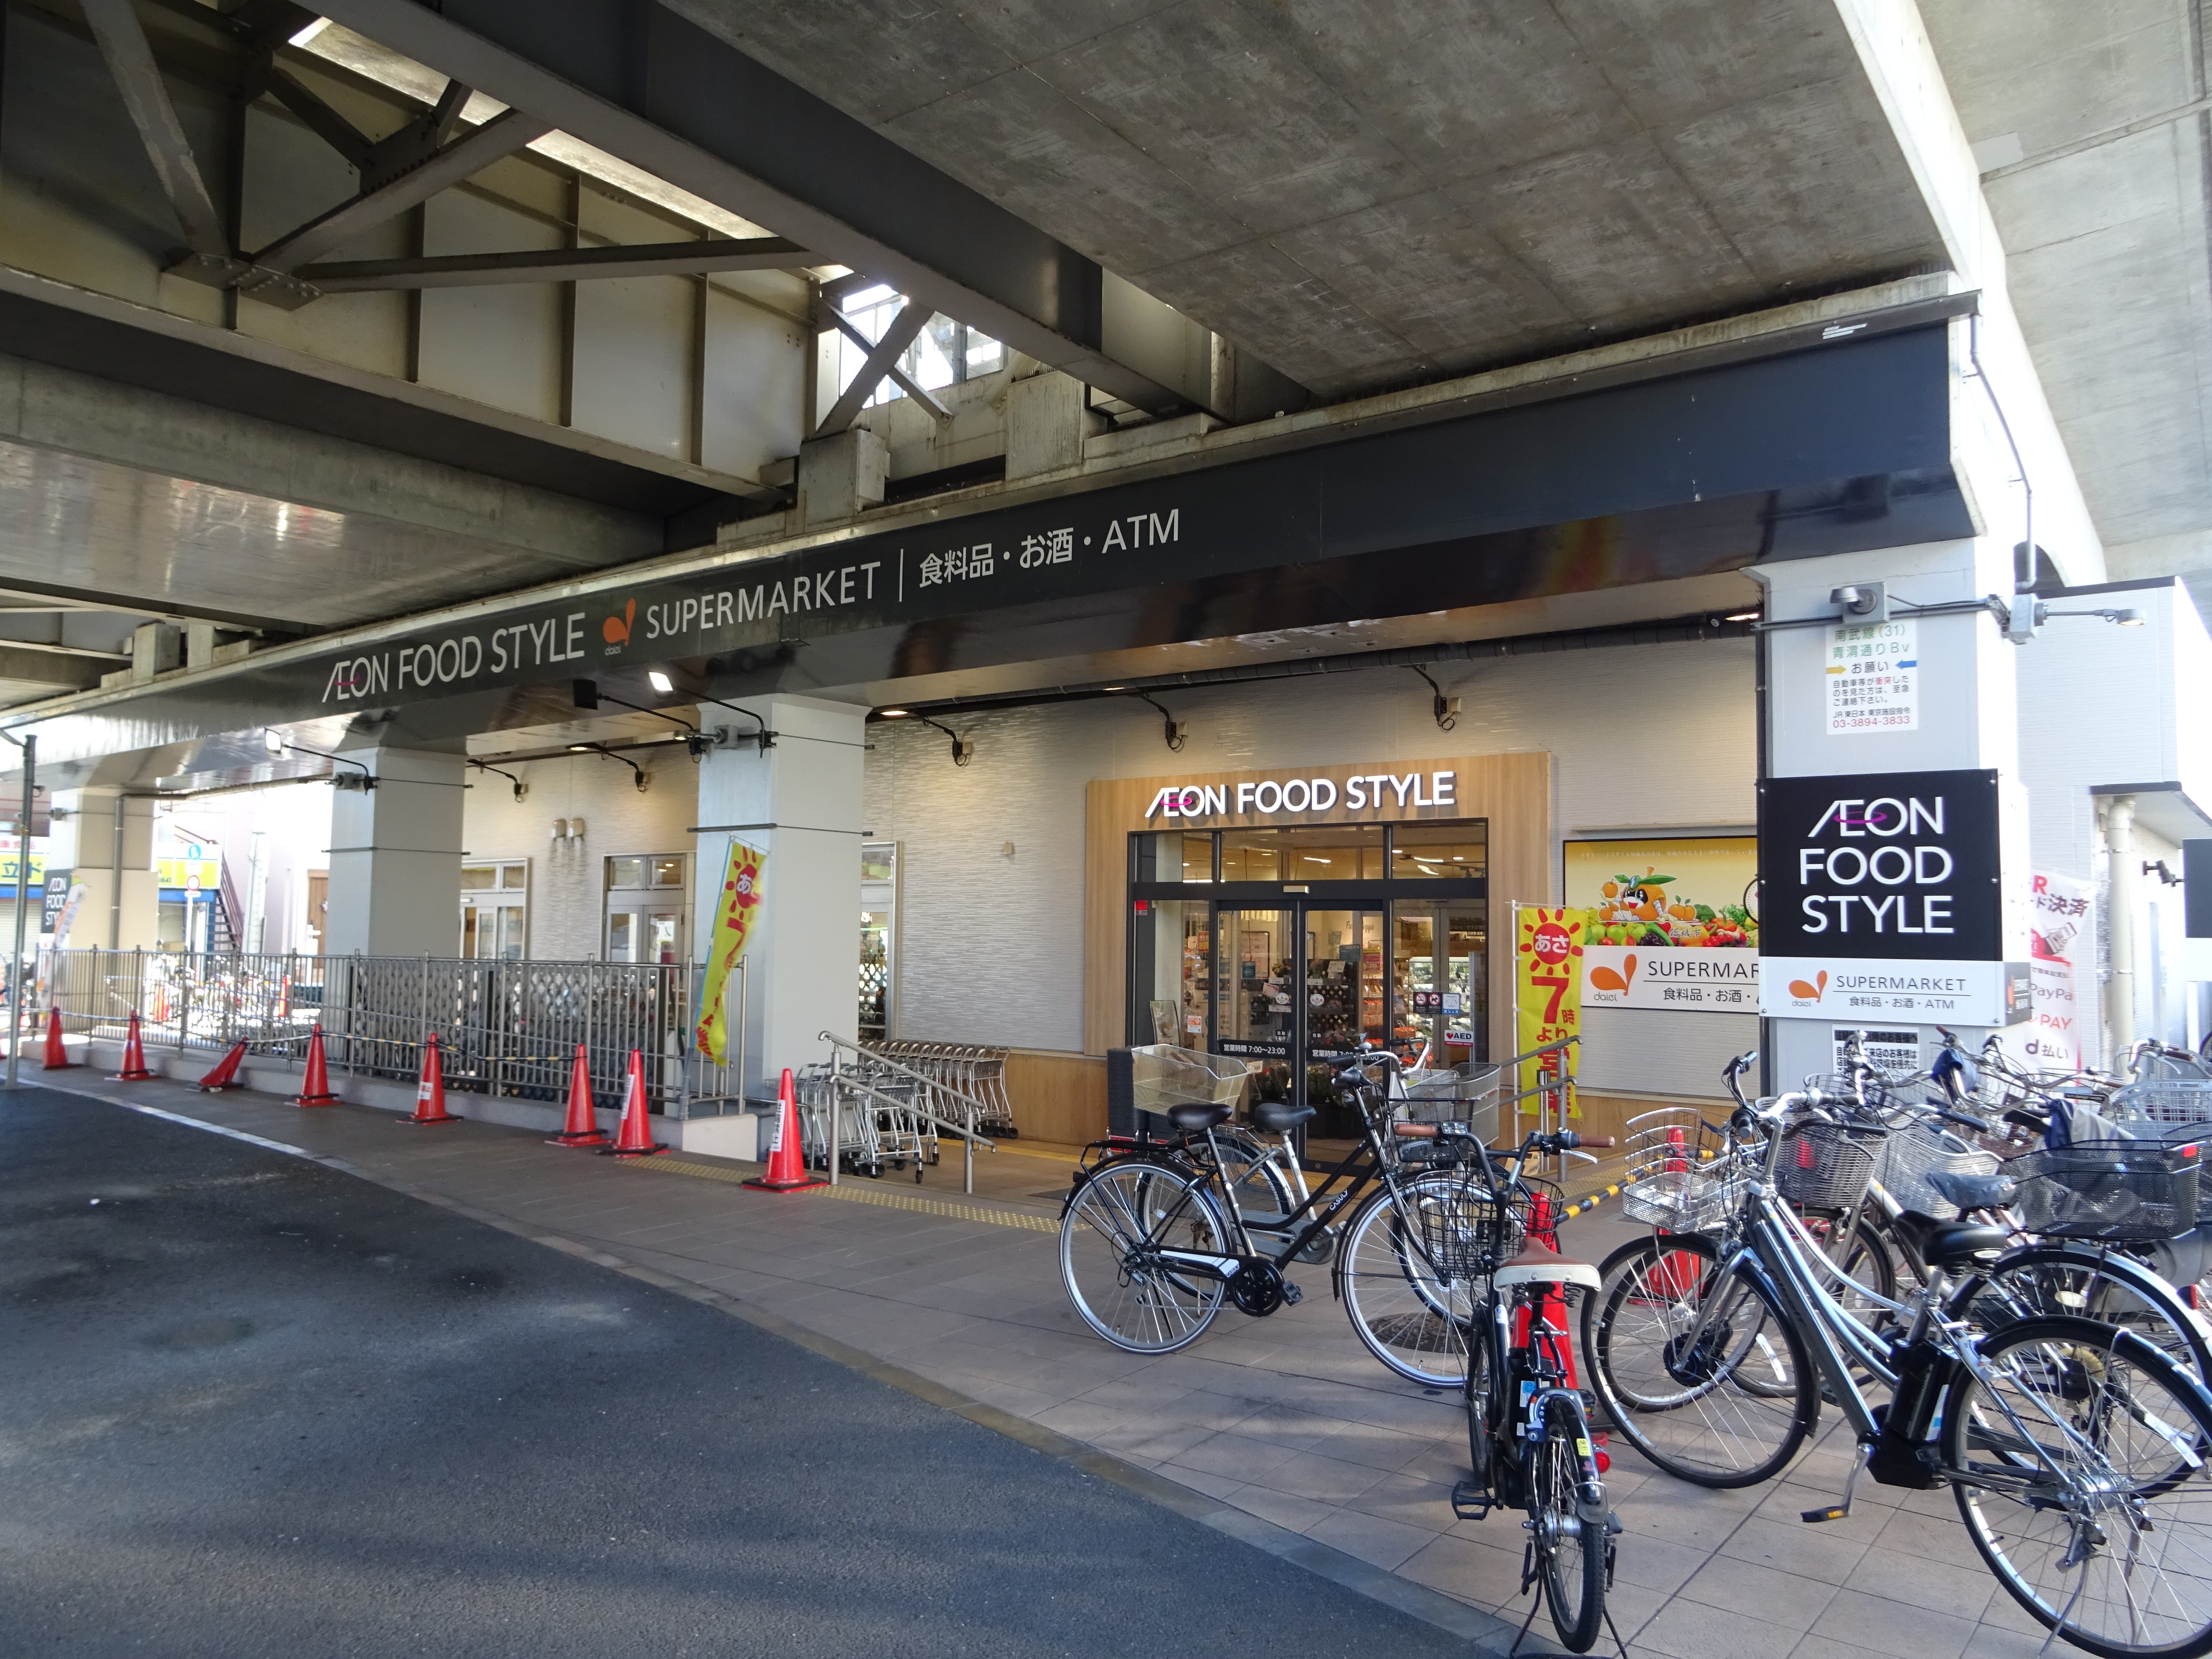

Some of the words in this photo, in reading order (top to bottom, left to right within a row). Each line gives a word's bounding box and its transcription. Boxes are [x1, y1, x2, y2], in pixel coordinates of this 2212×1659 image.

[646, 562, 881, 638] SUPERMARKET
[398, 636, 482, 689] FOOD
[490, 612, 585, 673] STYLE
[1851, 661, 1889, 674] お願い
[1833, 675, 1909, 688] 自動車等が衝突した
[1833, 716, 1910, 728] 03-3894-3833
[1238, 779, 1337, 813] FOOD
[1346, 771, 1454, 809] STYLE
[1800, 846, 1953, 885] FOOD
[1802, 895, 1955, 933] STYLE
[1535, 934, 1569, 954] あさ
[1837, 975, 1967, 991] SUPERMARKET
[1663, 987, 1759, 1004] 食料品・お酒・
[2040, 1014, 2072, 1030] PAY
[1223, 1044, 1247, 1053] 営業時間
[1312, 1049, 1337, 1058] 営業時間
